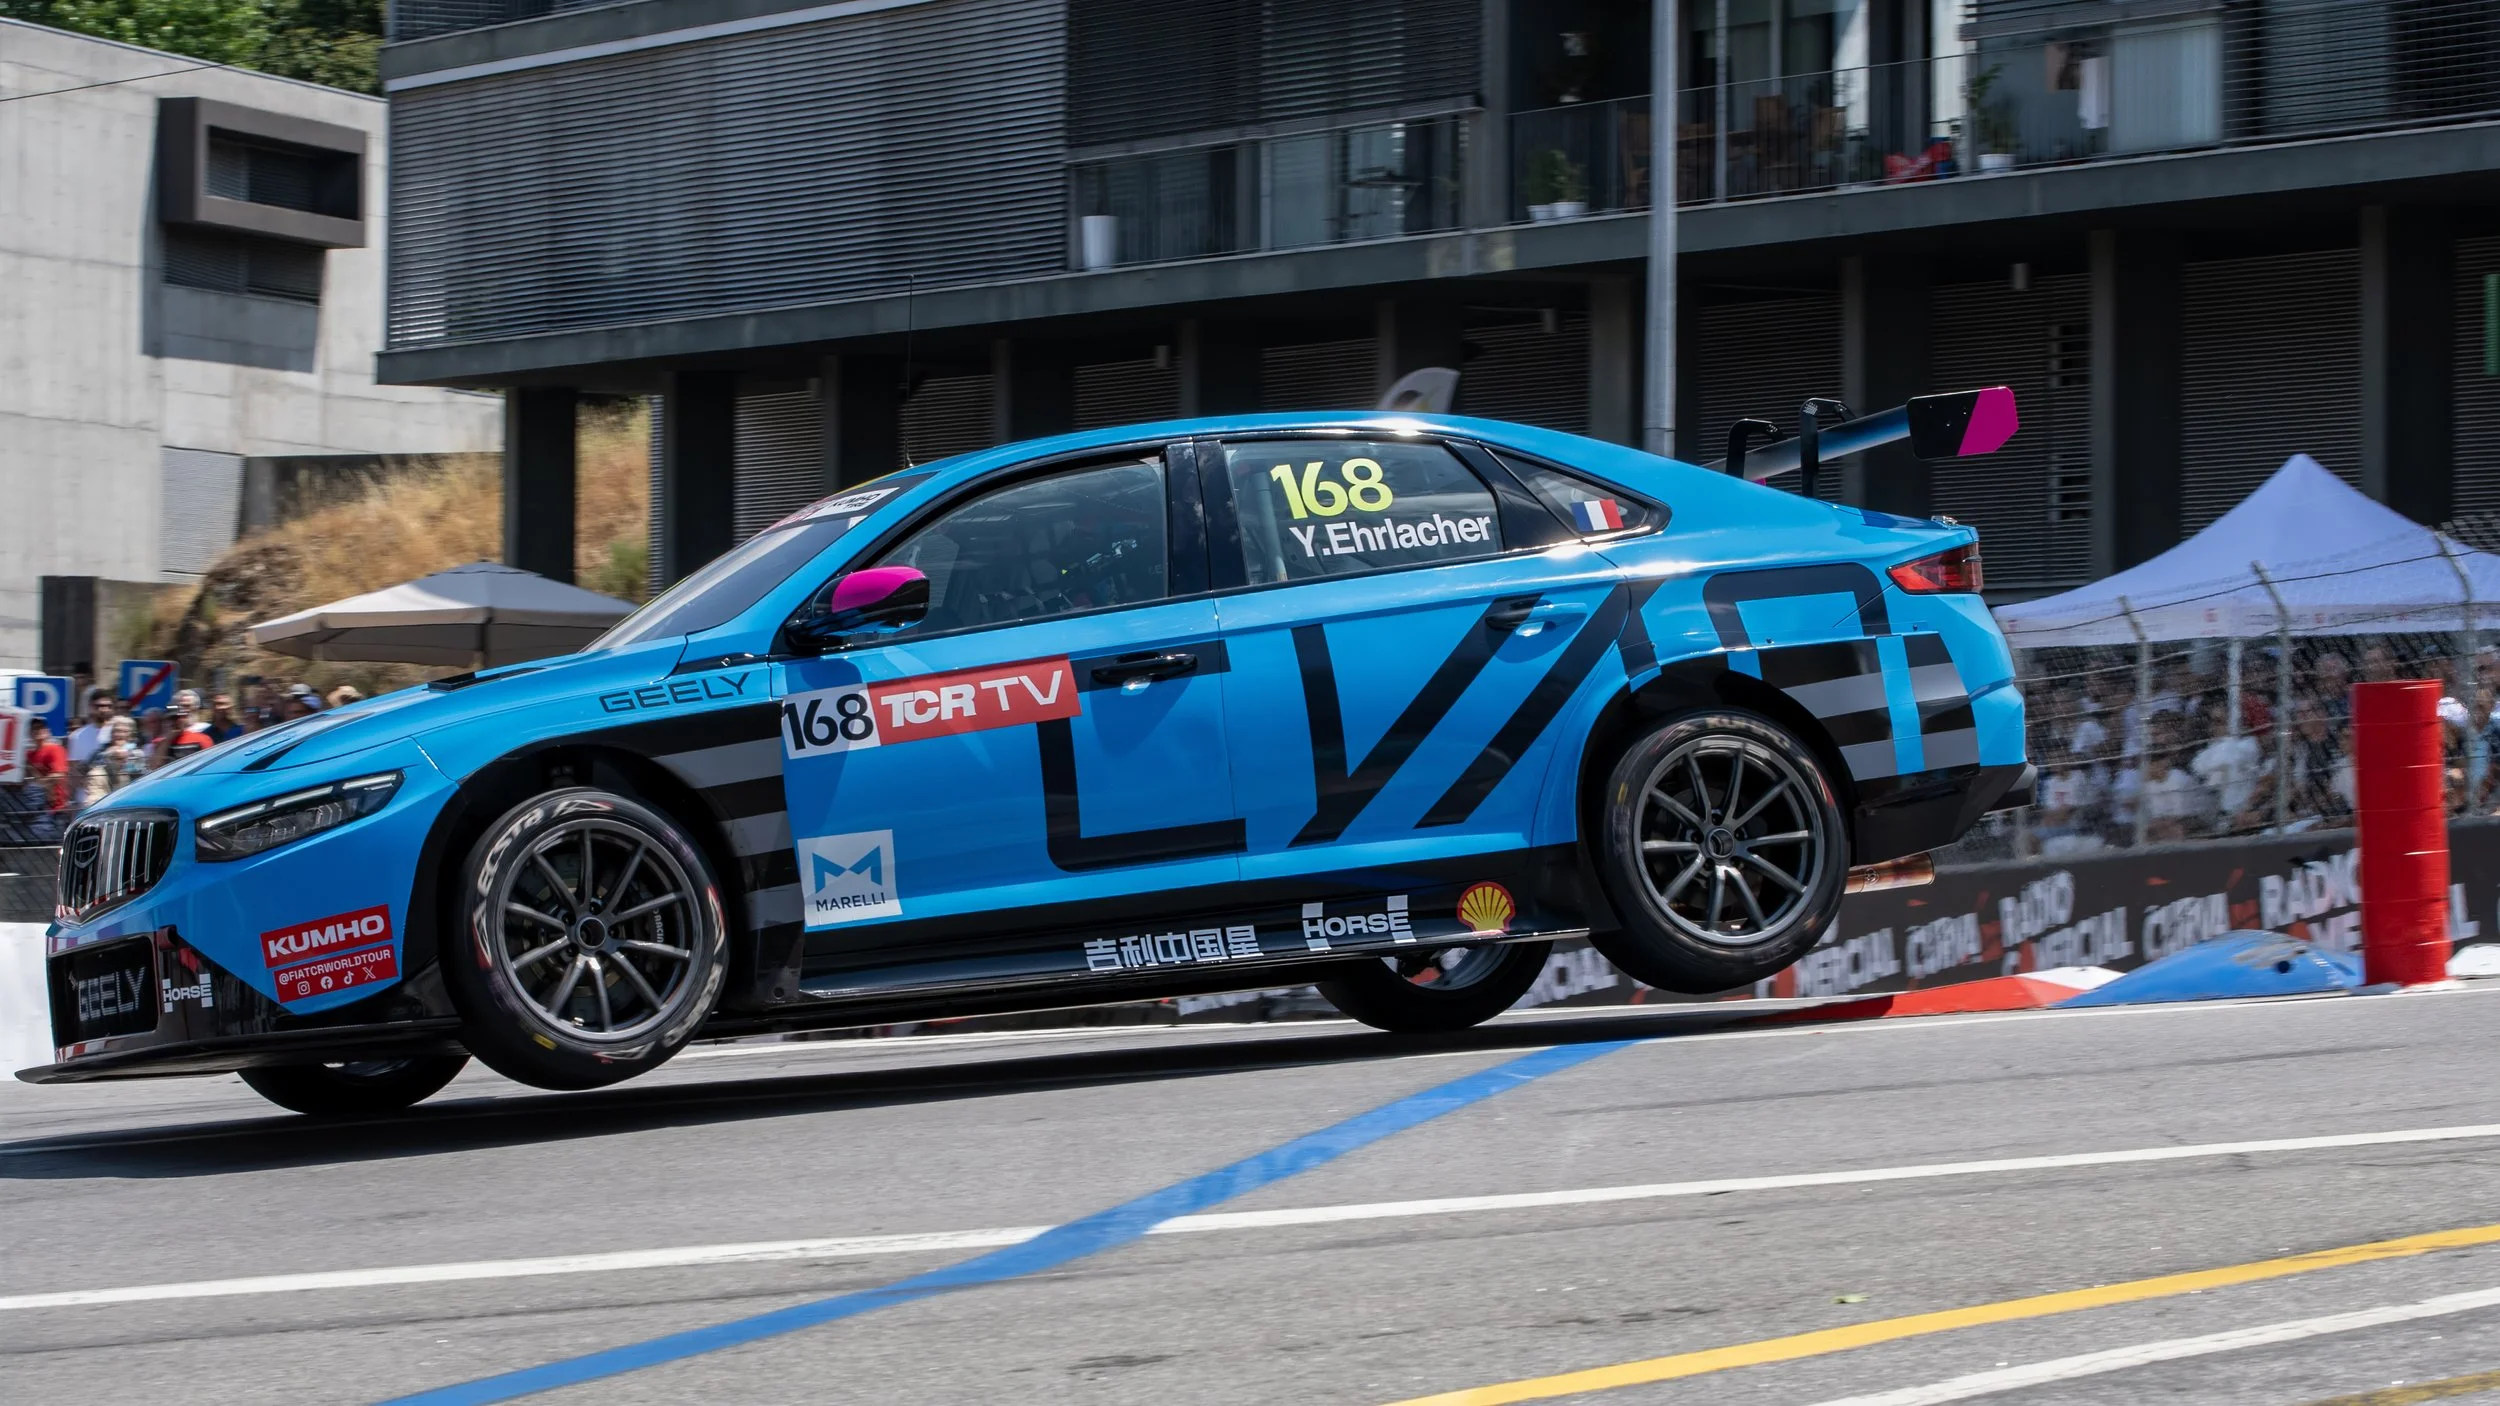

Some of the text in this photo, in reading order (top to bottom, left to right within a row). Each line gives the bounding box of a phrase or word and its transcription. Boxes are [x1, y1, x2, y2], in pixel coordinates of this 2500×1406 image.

[1270, 458, 1393, 519] 168
[1289, 513, 1491, 557] Y.Ehrlacher
[599, 672, 750, 713] GEELY
[782, 669, 1063, 751] 168 TCR TV
[815, 892, 886, 912] MARELLI
[267, 914, 385, 958] KUMHO
[653, 914, 665, 943] RACIN
[1083, 925, 1264, 971] 吉利中国星
[278, 949, 391, 985] @FIATCRWORLDTOUR
[78, 966, 146, 1022] GEELY
